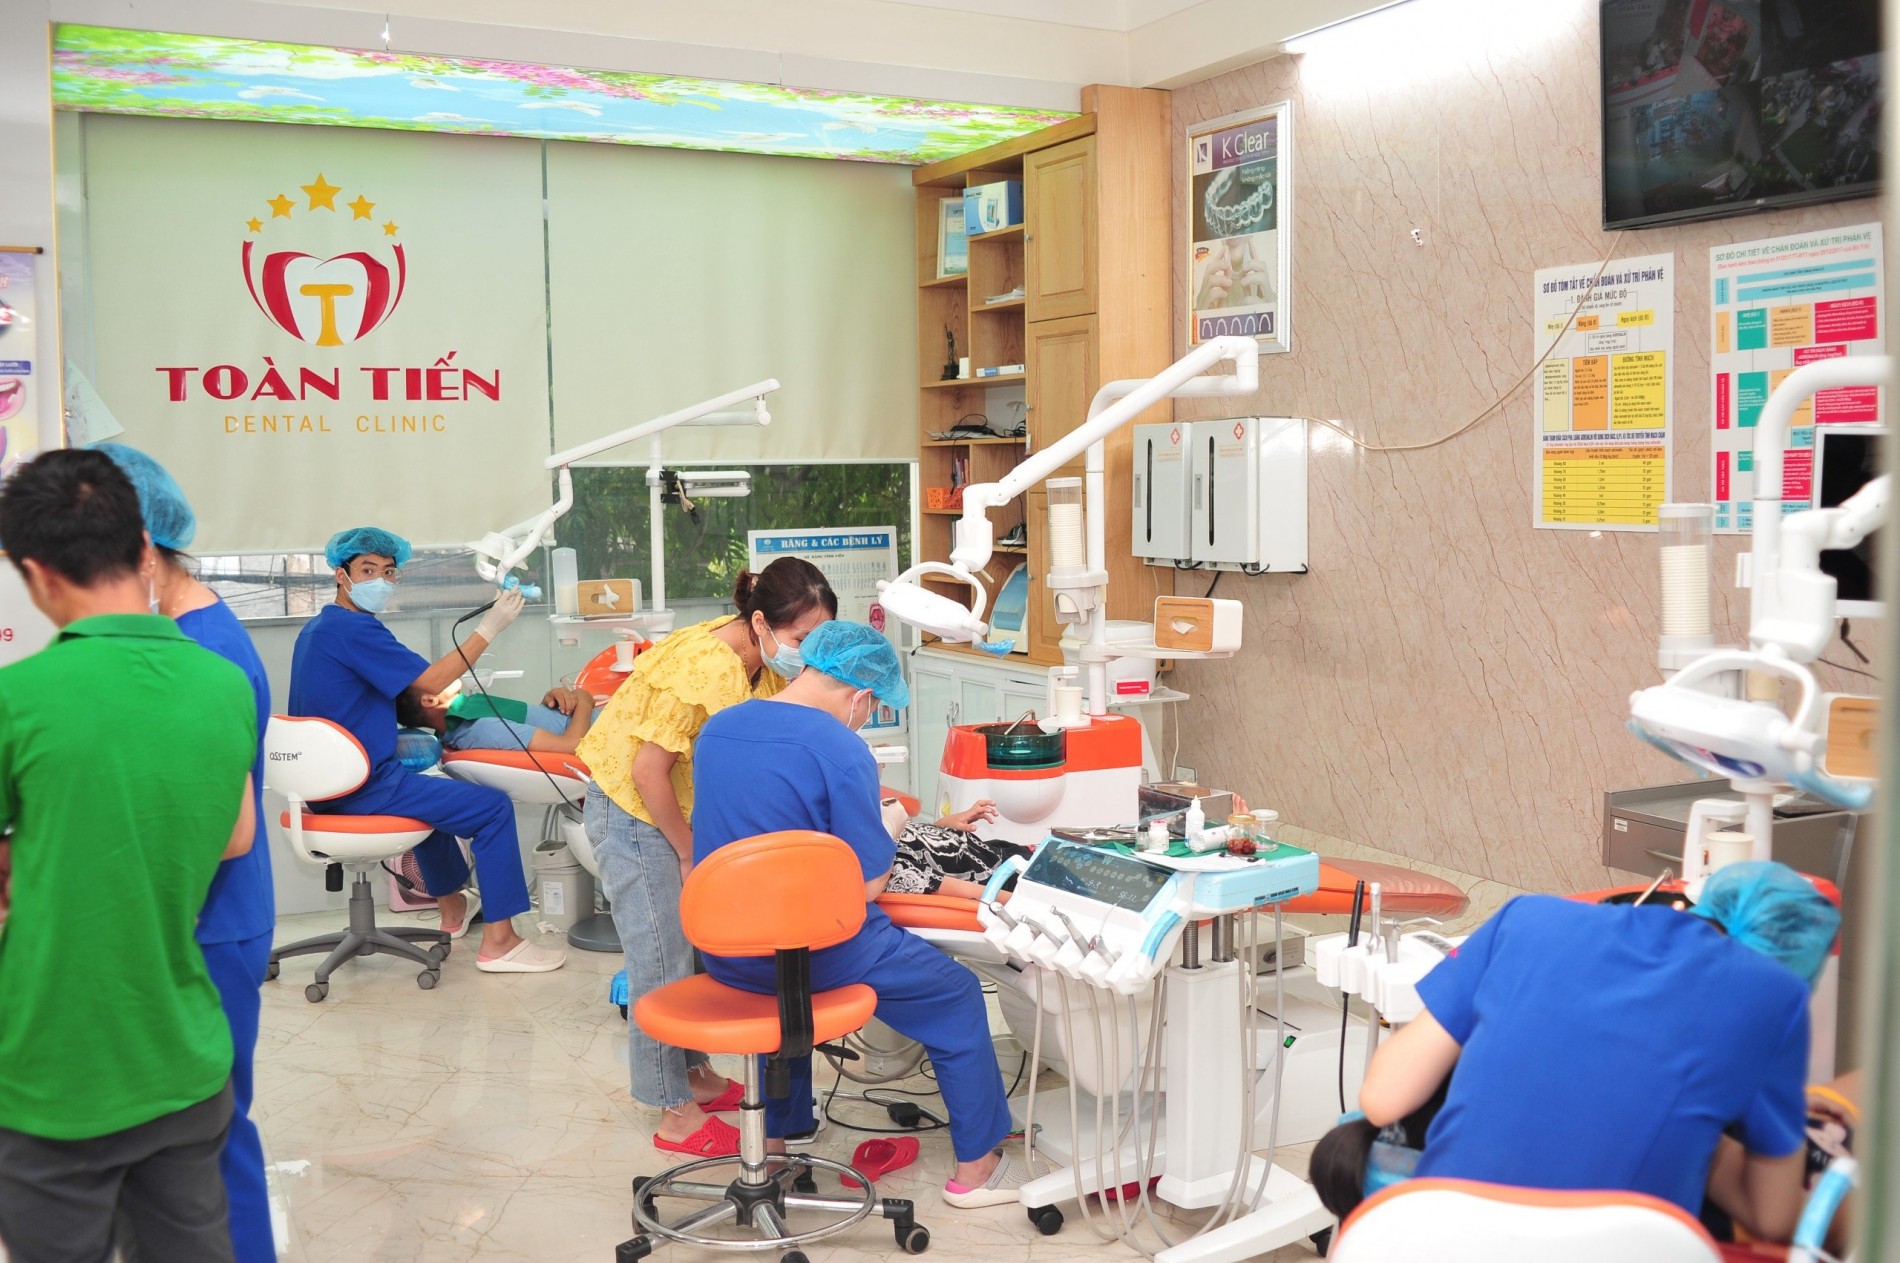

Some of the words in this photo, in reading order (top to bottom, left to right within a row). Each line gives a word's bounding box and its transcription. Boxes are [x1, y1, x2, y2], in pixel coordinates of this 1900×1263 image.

[1222, 136, 1232, 159] K
[1234, 131, 1270, 156] Clear
[155, 355, 340, 401] TOÀN
[360, 350, 500, 401] TIẾN
[224, 415, 332, 433] DENTAL
[356, 414, 447, 433] CLINIC
[781, 540, 808, 548] RĂNG
[821, 538, 840, 546] CÁC
[842, 536, 868, 547] BỆNH
